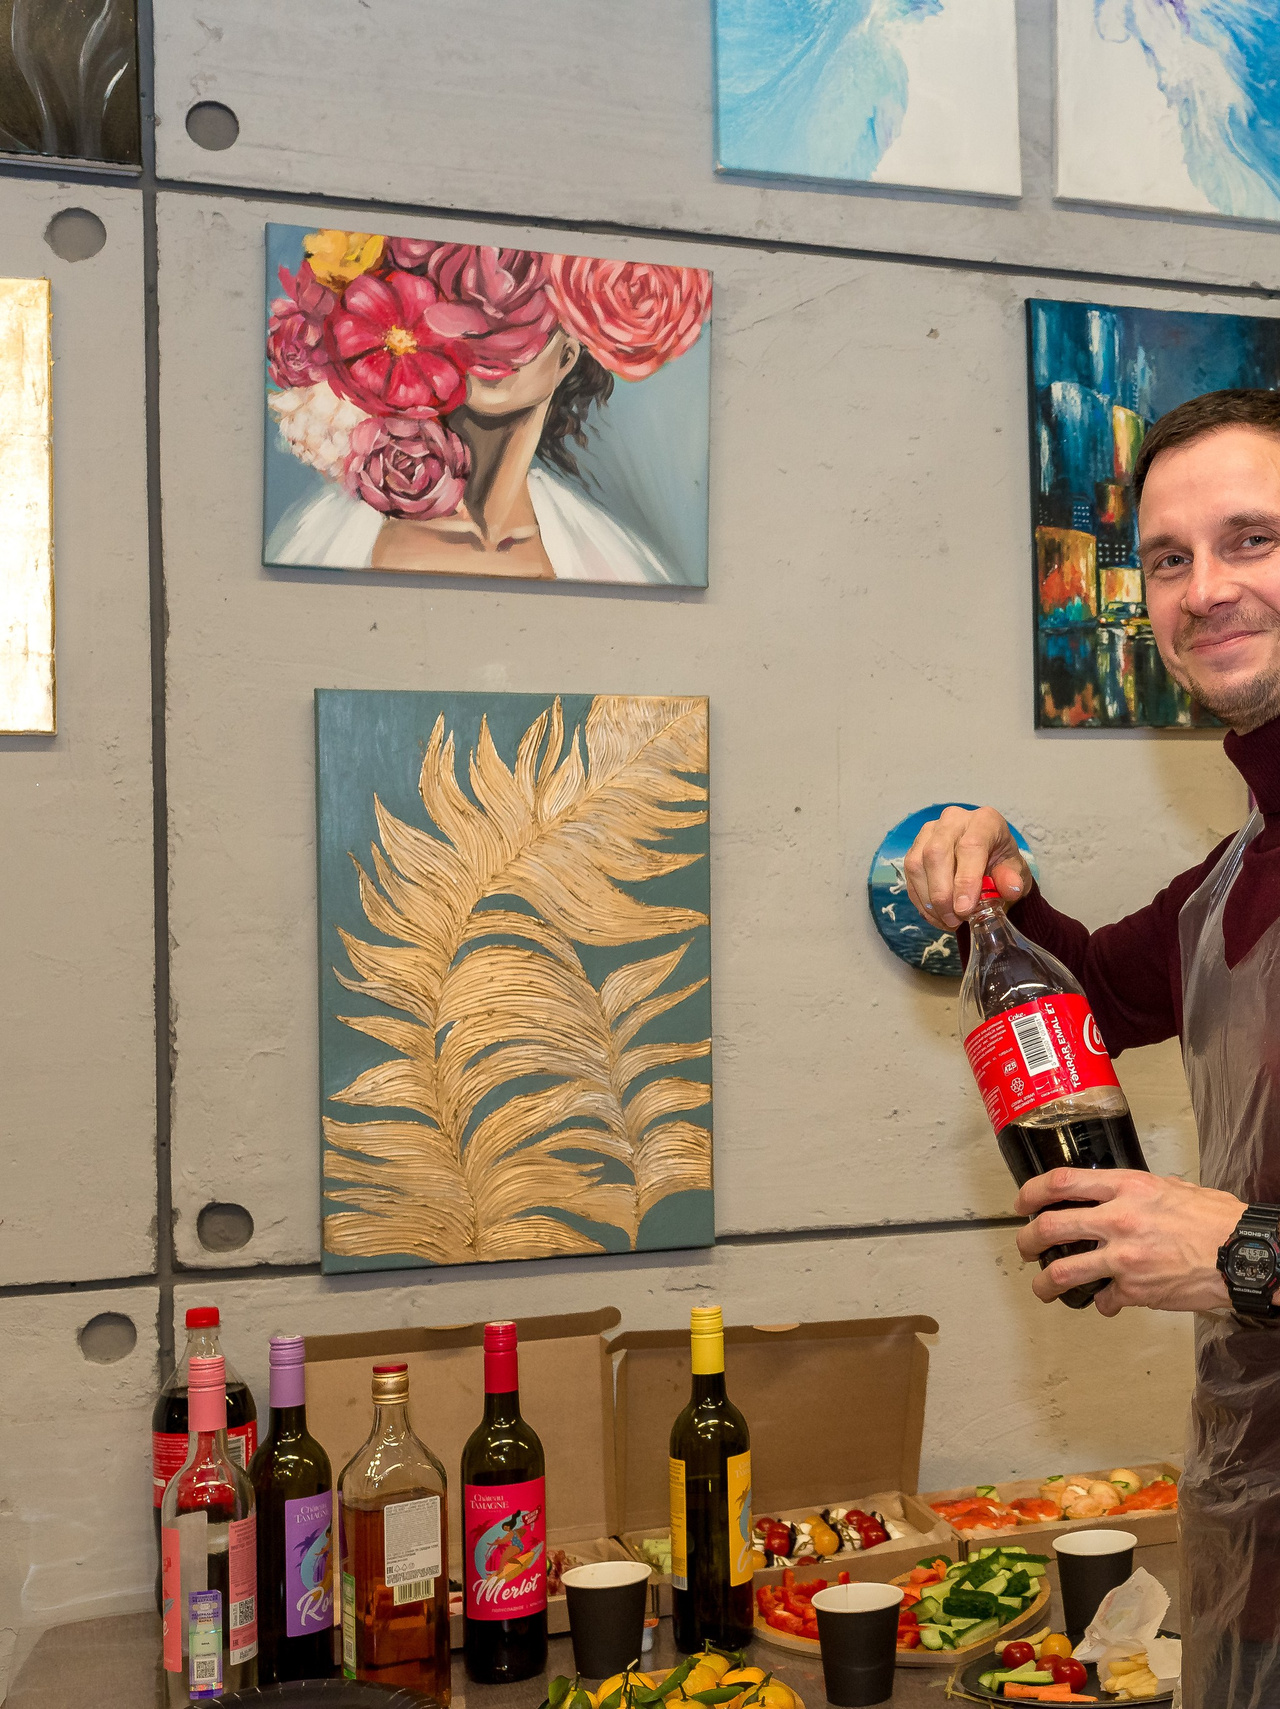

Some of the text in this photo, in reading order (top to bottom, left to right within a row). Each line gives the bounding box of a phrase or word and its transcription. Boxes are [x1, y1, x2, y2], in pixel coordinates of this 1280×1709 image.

[1007, 1011, 1026, 1022] Coke
[1052, 1015, 1067, 1045] EMAL
[1062, 1046, 1082, 1088] TƏKRAR
[1239, 1230, 1270, 1238] G-SHOCK
[1233, 1287, 1262, 1295] PROTECTION
[470, 1501, 509, 1510] TAMAGNE
[472, 1573, 542, 1606] Merlot
